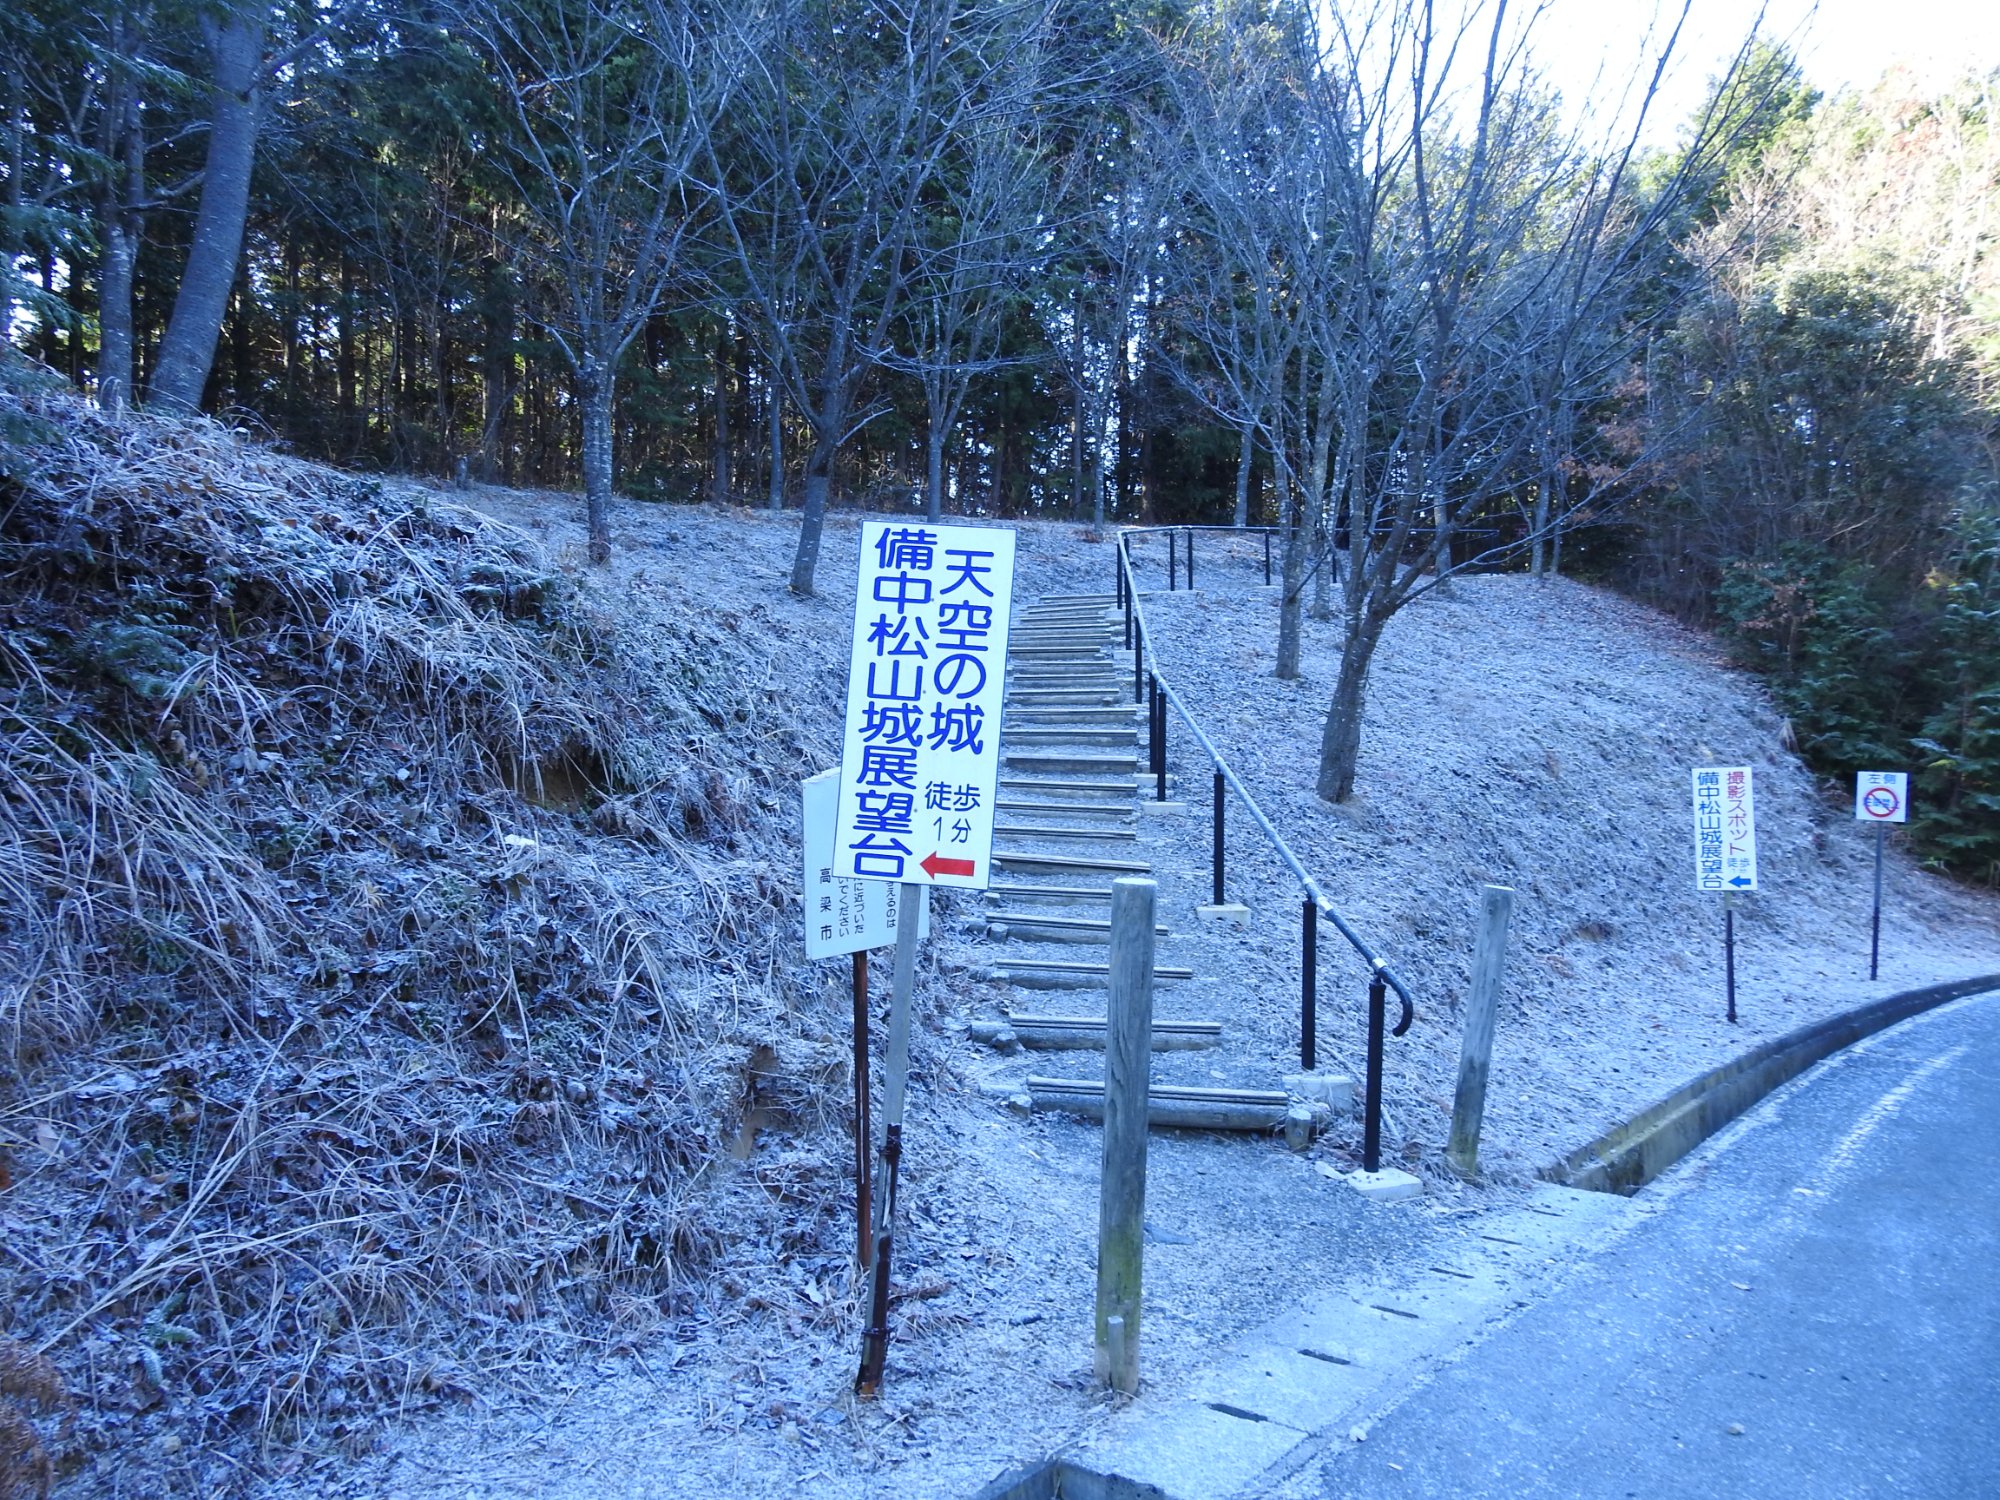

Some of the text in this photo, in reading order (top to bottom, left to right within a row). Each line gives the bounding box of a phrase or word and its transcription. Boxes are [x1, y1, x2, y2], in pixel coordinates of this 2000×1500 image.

[926, 550, 995, 755] 天空の城
[849, 527, 938, 879] 備中松山城展望台
[924, 781, 981, 812] 徒歩
[933, 818, 972, 844] 1分
[1697, 772, 1724, 889] 備中松山城展望台
[1727, 771, 1747, 855] 撮影スポット
[819, 868, 833, 941] 高梁市
[854, 878, 865, 935] に近づいた
